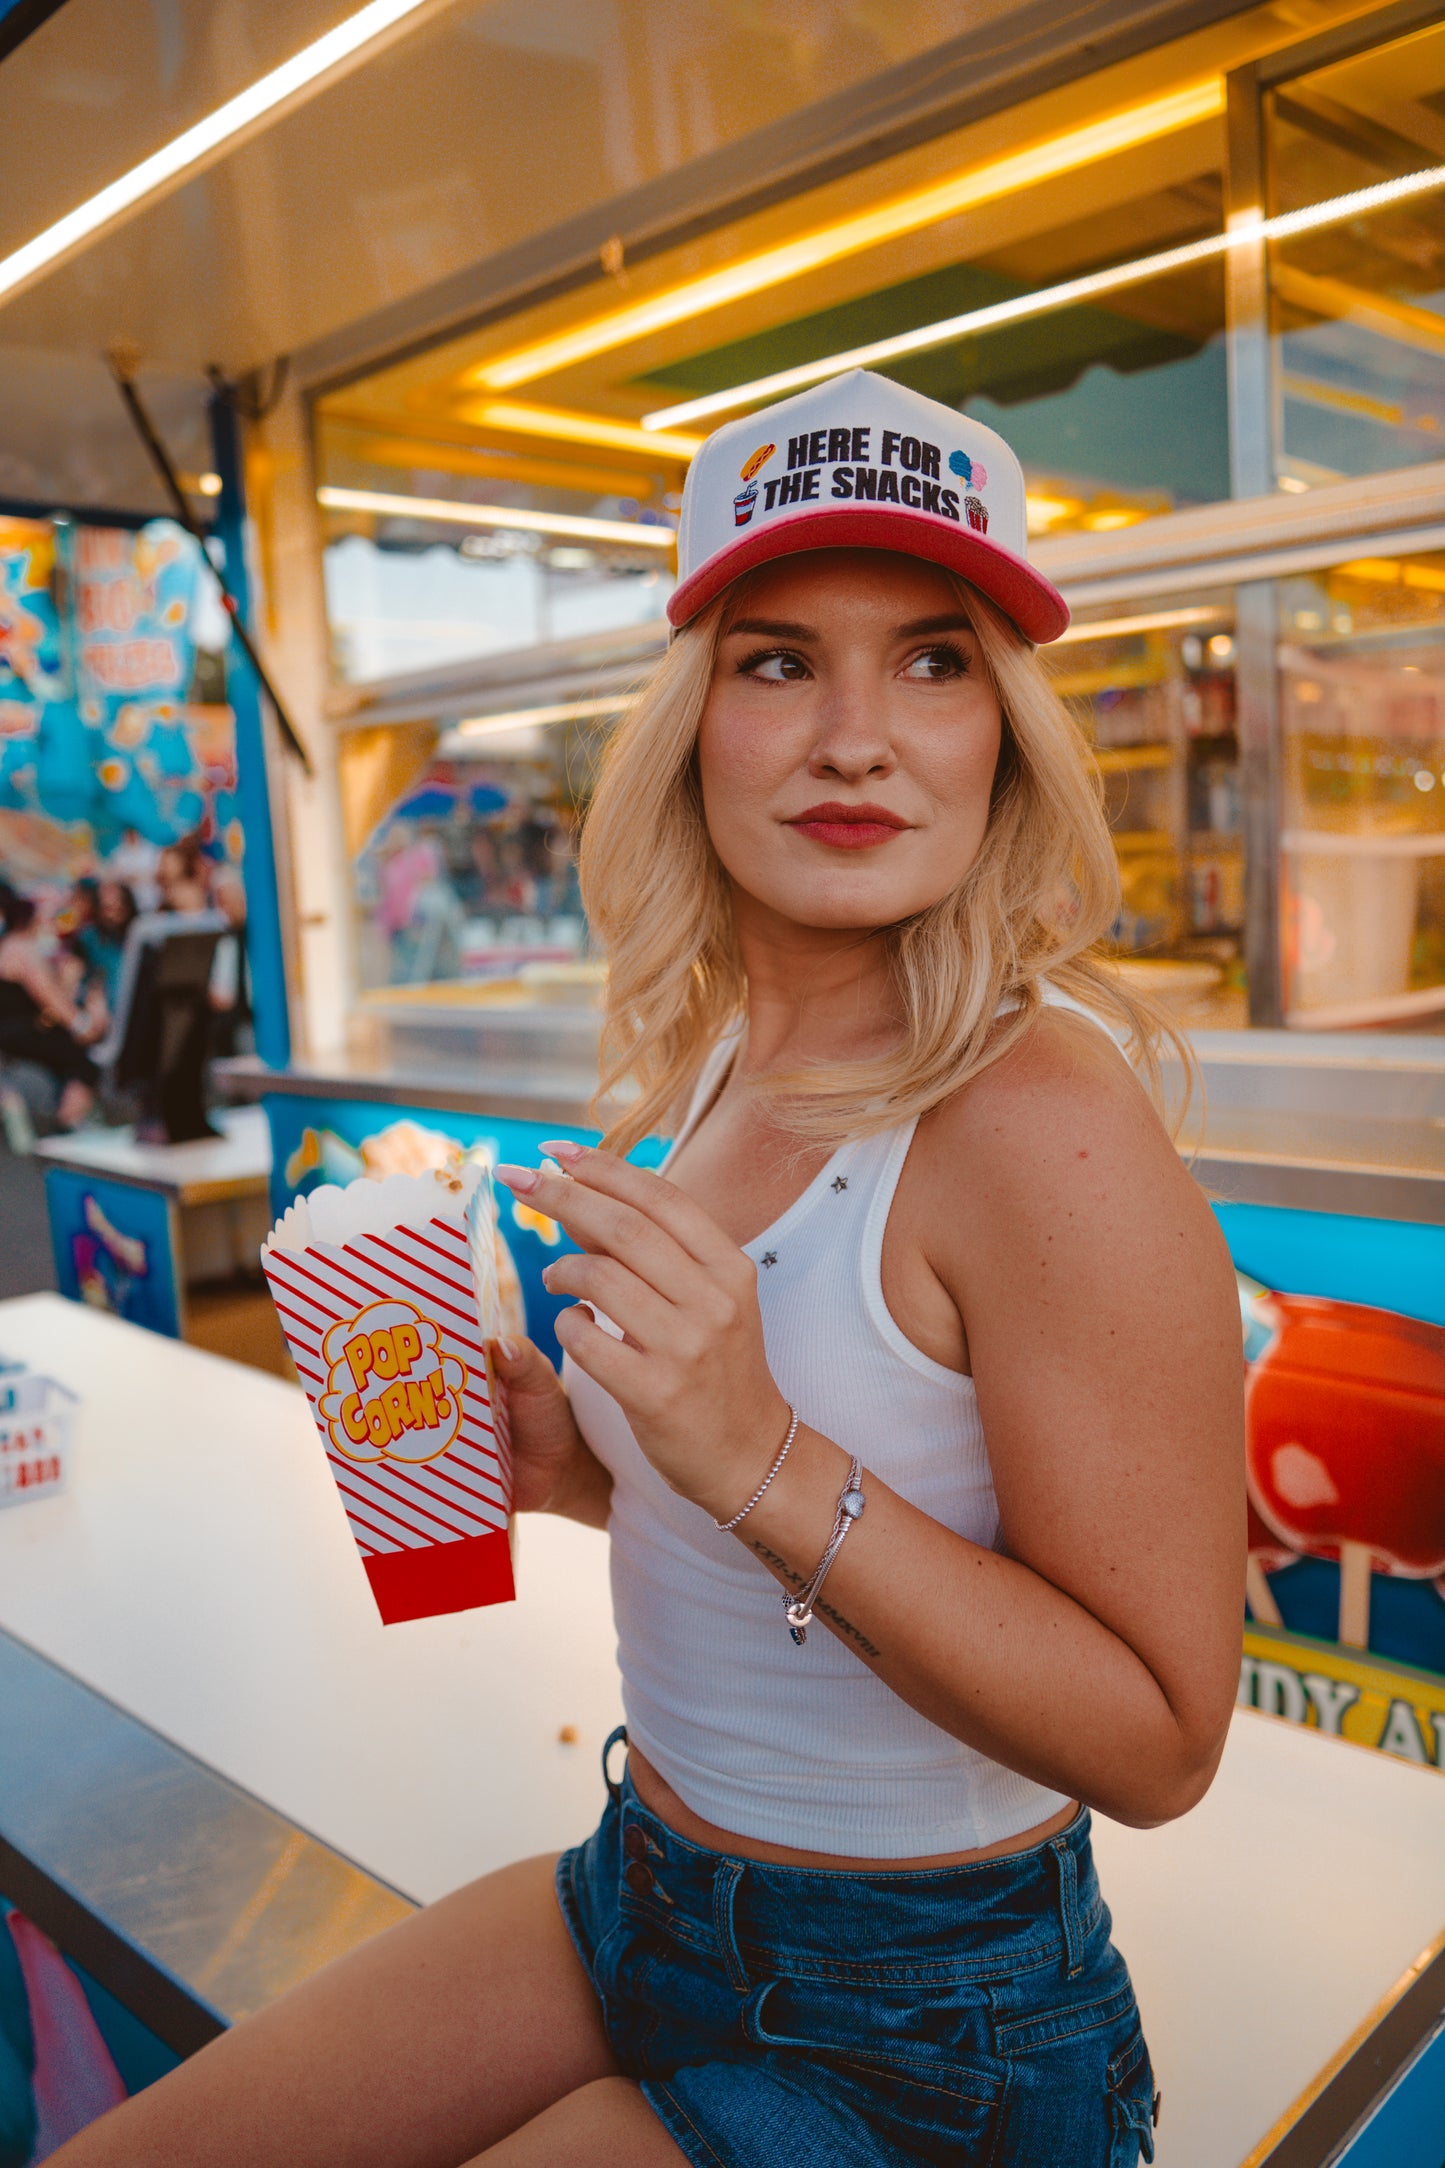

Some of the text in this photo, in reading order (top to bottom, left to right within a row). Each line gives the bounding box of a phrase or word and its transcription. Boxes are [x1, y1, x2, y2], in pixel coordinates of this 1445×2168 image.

[787, 428, 942, 480] HERE FOR
[764, 467, 960, 521] THE SNACKS
[343, 1324, 423, 1393] POP
[340, 1369, 451, 1448] CORN!
[1378, 1698, 1445, 1769] A
